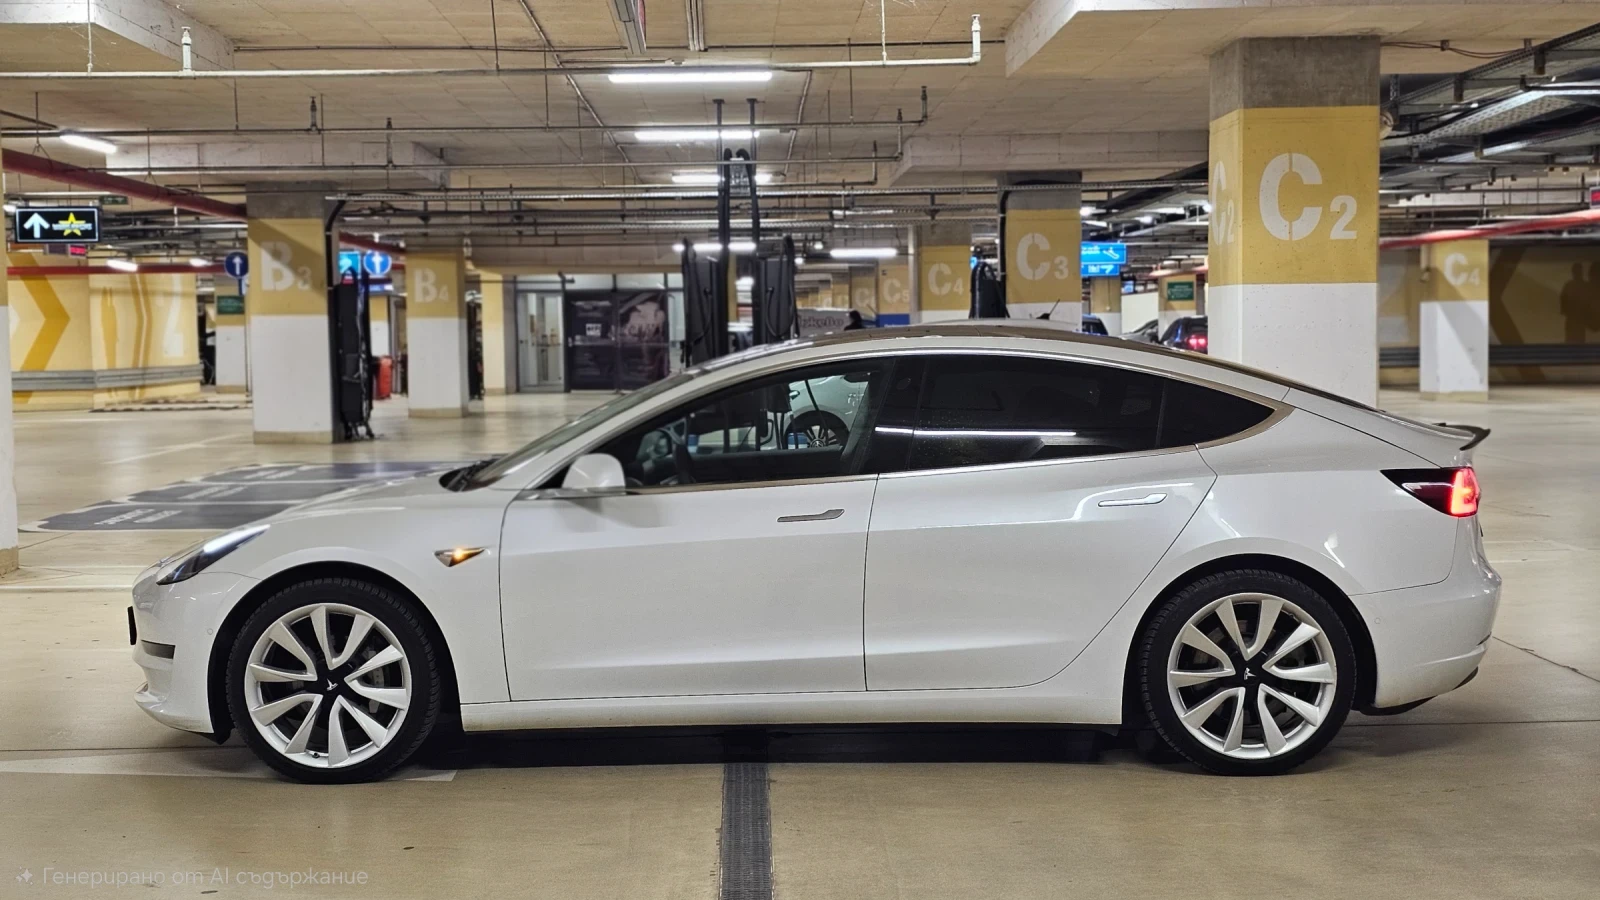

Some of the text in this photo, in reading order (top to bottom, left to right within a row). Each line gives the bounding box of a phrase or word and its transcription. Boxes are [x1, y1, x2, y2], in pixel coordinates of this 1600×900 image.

[1259, 152, 1357, 241] C2
[260, 241, 311, 291] B3
[927, 262, 964, 296] C4
[1016, 232, 1069, 281] C3
